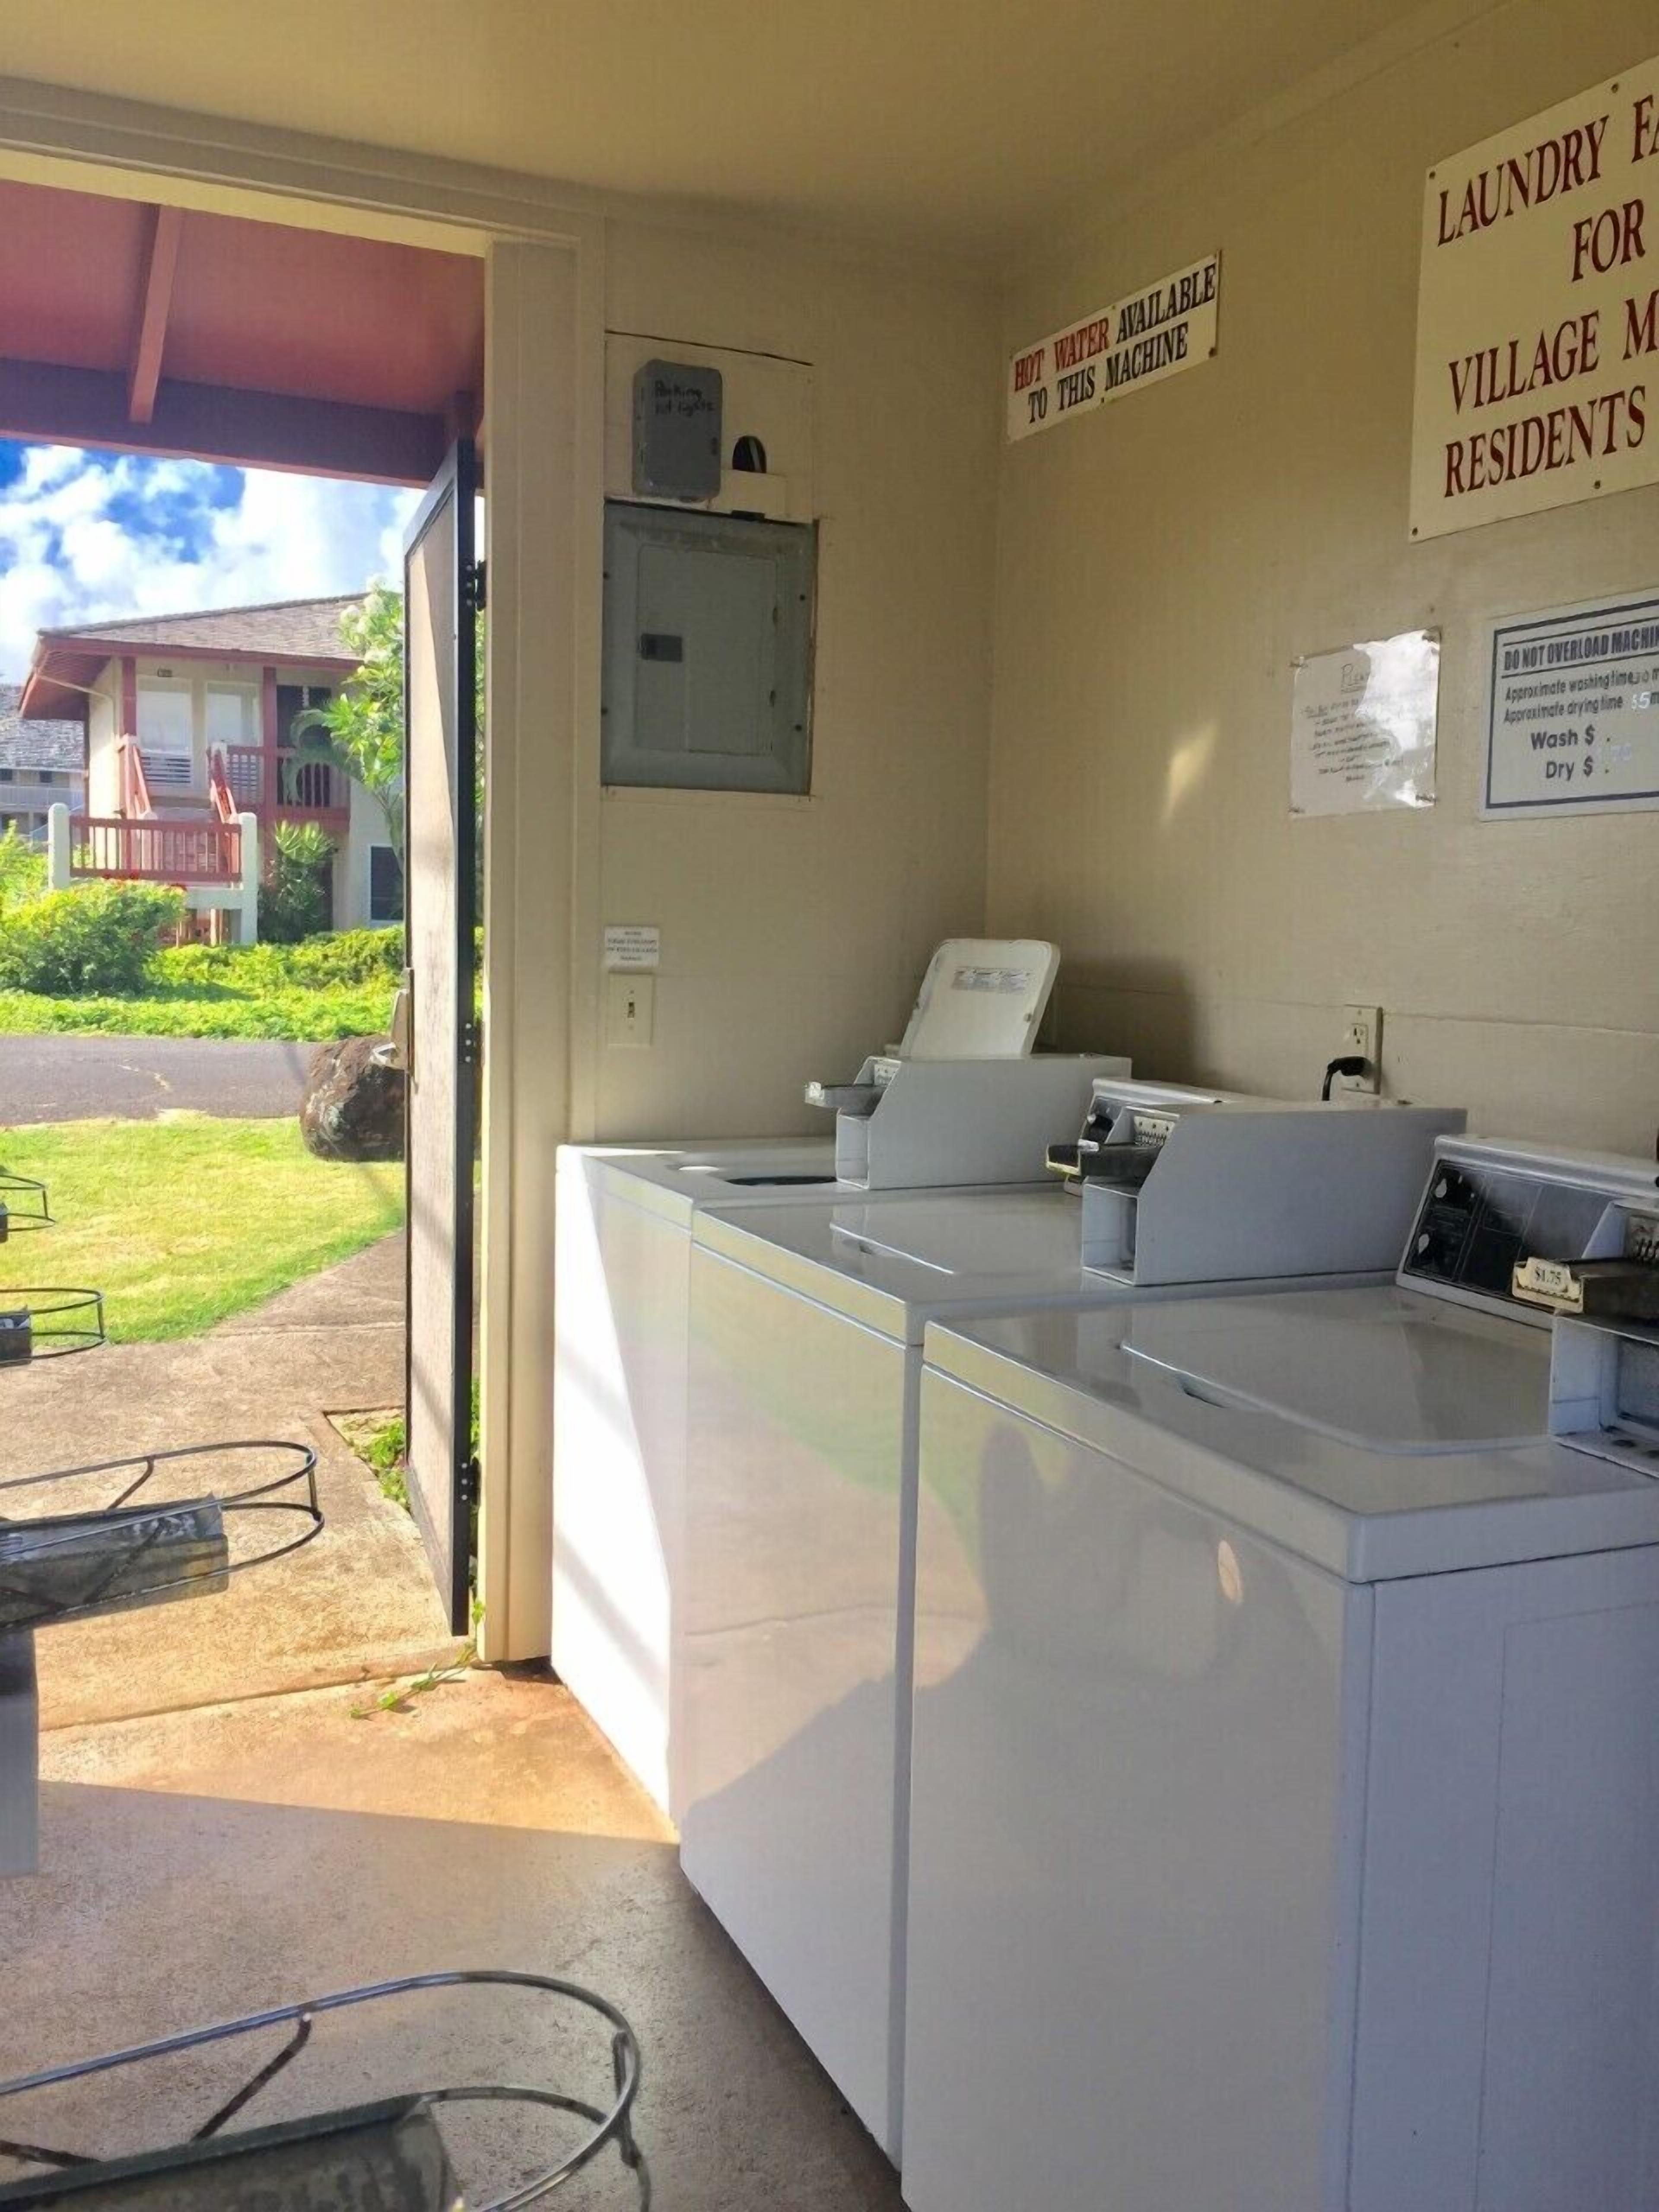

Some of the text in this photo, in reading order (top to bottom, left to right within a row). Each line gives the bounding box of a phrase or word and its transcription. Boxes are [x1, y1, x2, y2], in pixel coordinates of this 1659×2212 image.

[1437, 115, 1609, 247] LAUNDRY
[1571, 199, 1646, 282] FOR
[1014, 263, 1216, 392] HOT WATER AVAILABLE
[1448, 310, 1599, 415] VILLAGE
[1029, 321, 1189, 423] TO THIS MACHINE
[1444, 386, 1646, 498] RESIDENTS
[1504, 649, 1519, 671] DO
[1522, 645, 1545, 668] NOT
[1547, 634, 1610, 664] OVERLOAD
[1506, 679, 1566, 703] Approximate
[1569, 672, 1610, 692] washing
[1503, 701, 1565, 725] Approximate
[1567, 699, 1599, 718] drying
[1531, 724, 1595, 750] Wash $
[1546, 756, 1593, 781] Dry $
